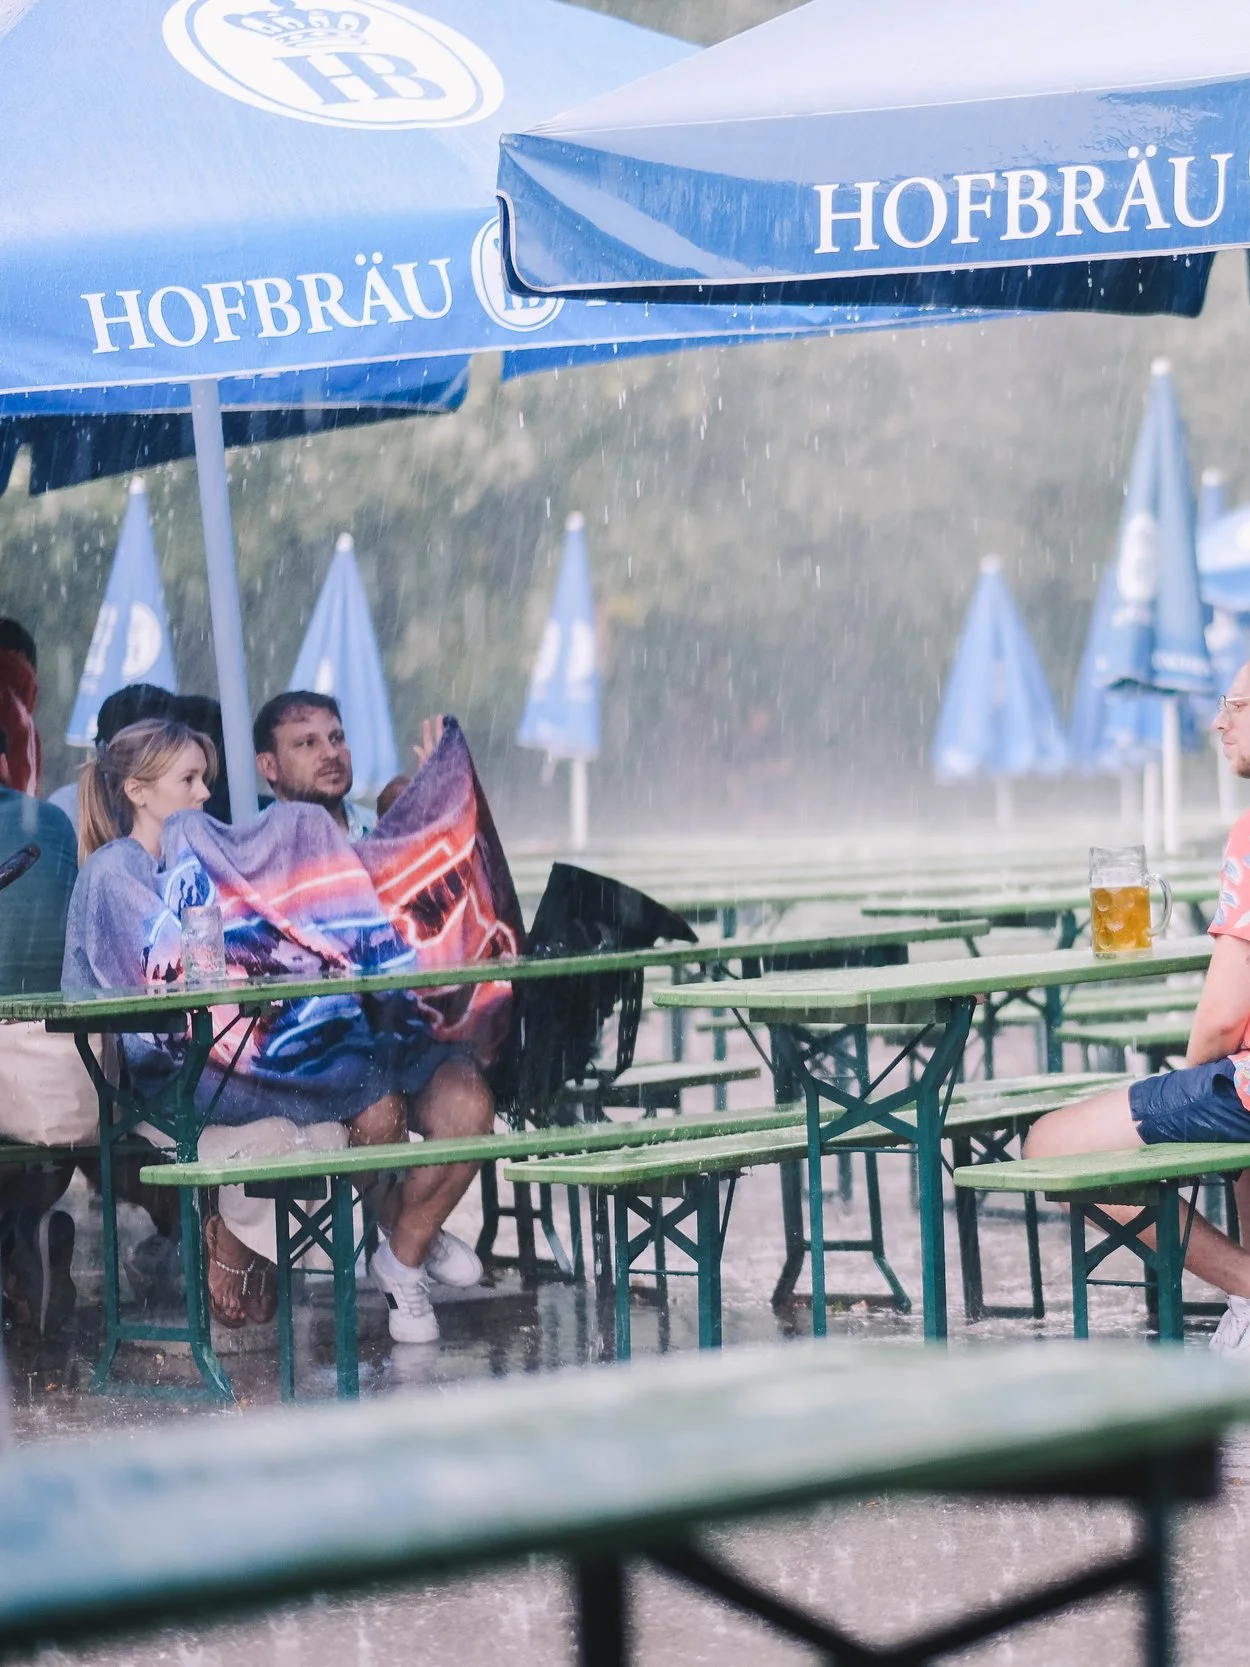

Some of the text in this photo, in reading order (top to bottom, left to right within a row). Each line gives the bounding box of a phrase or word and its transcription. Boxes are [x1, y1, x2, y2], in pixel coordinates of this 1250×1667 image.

[273, 51, 447, 106] HB
[812, 144, 1234, 255] HOFBRÄU
[80, 251, 454, 355] HOFBRÄU
